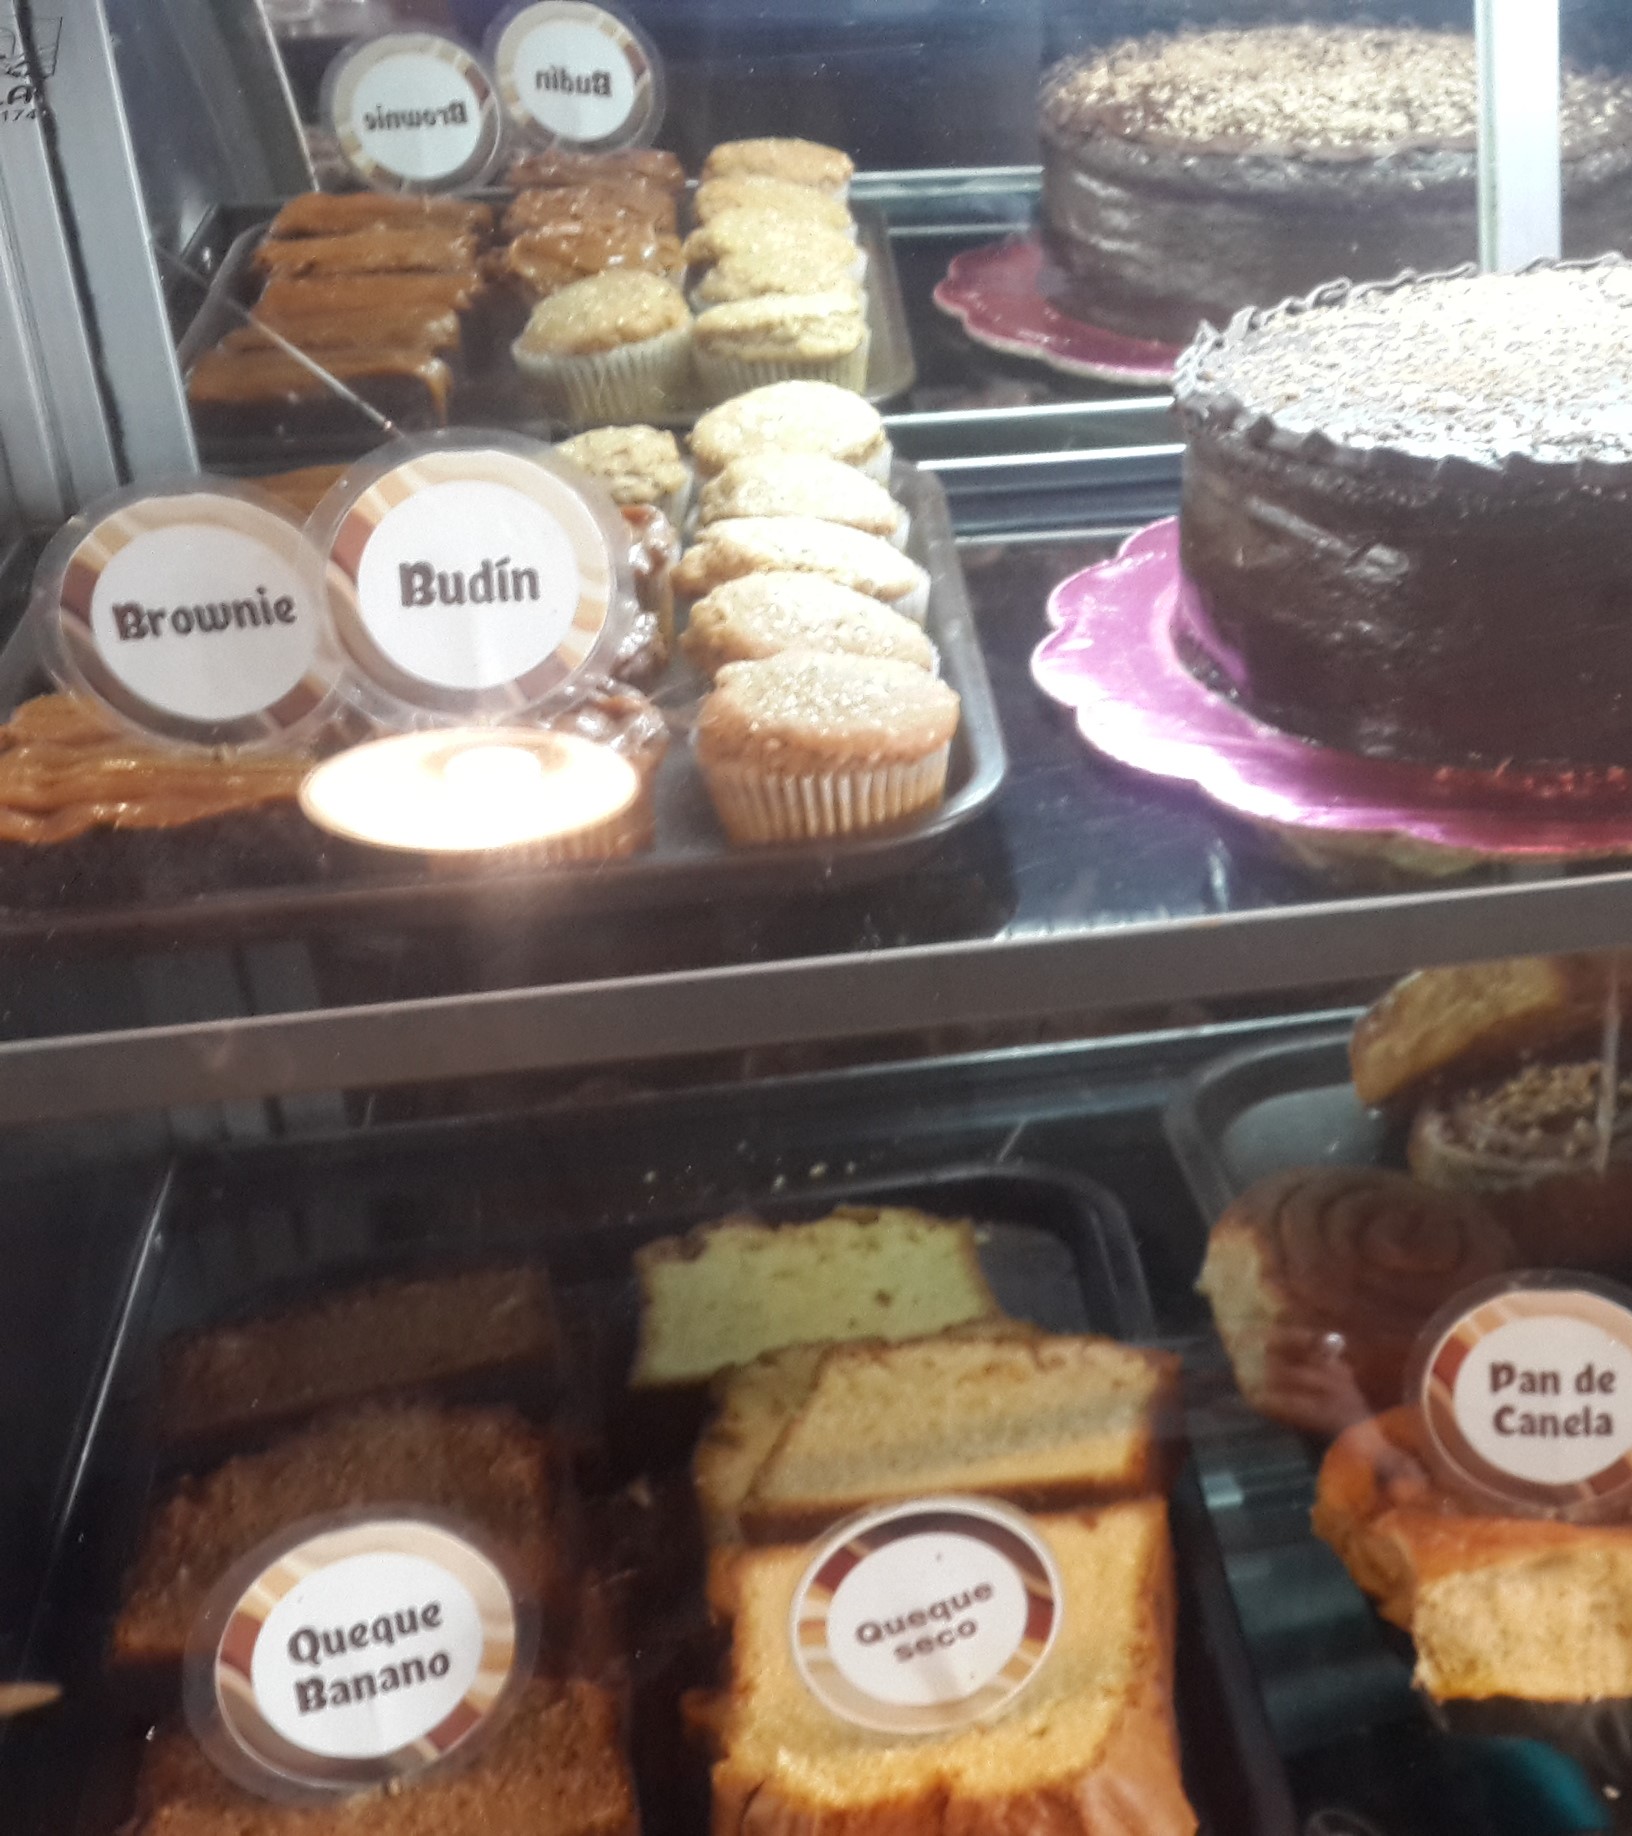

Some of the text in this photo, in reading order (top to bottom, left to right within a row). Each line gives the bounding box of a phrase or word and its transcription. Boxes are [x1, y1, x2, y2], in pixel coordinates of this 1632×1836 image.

[398, 556, 542, 608] Budín
[111, 585, 298, 642] Brownie
[1489, 1360, 1617, 1395] Pan de
[1492, 1404, 1614, 1437] Canela
[287, 1601, 443, 1666] Queque
[855, 1582, 994, 1645] Queque
[894, 1620, 977, 1662] seco
[294, 1651, 450, 1716] Banano
